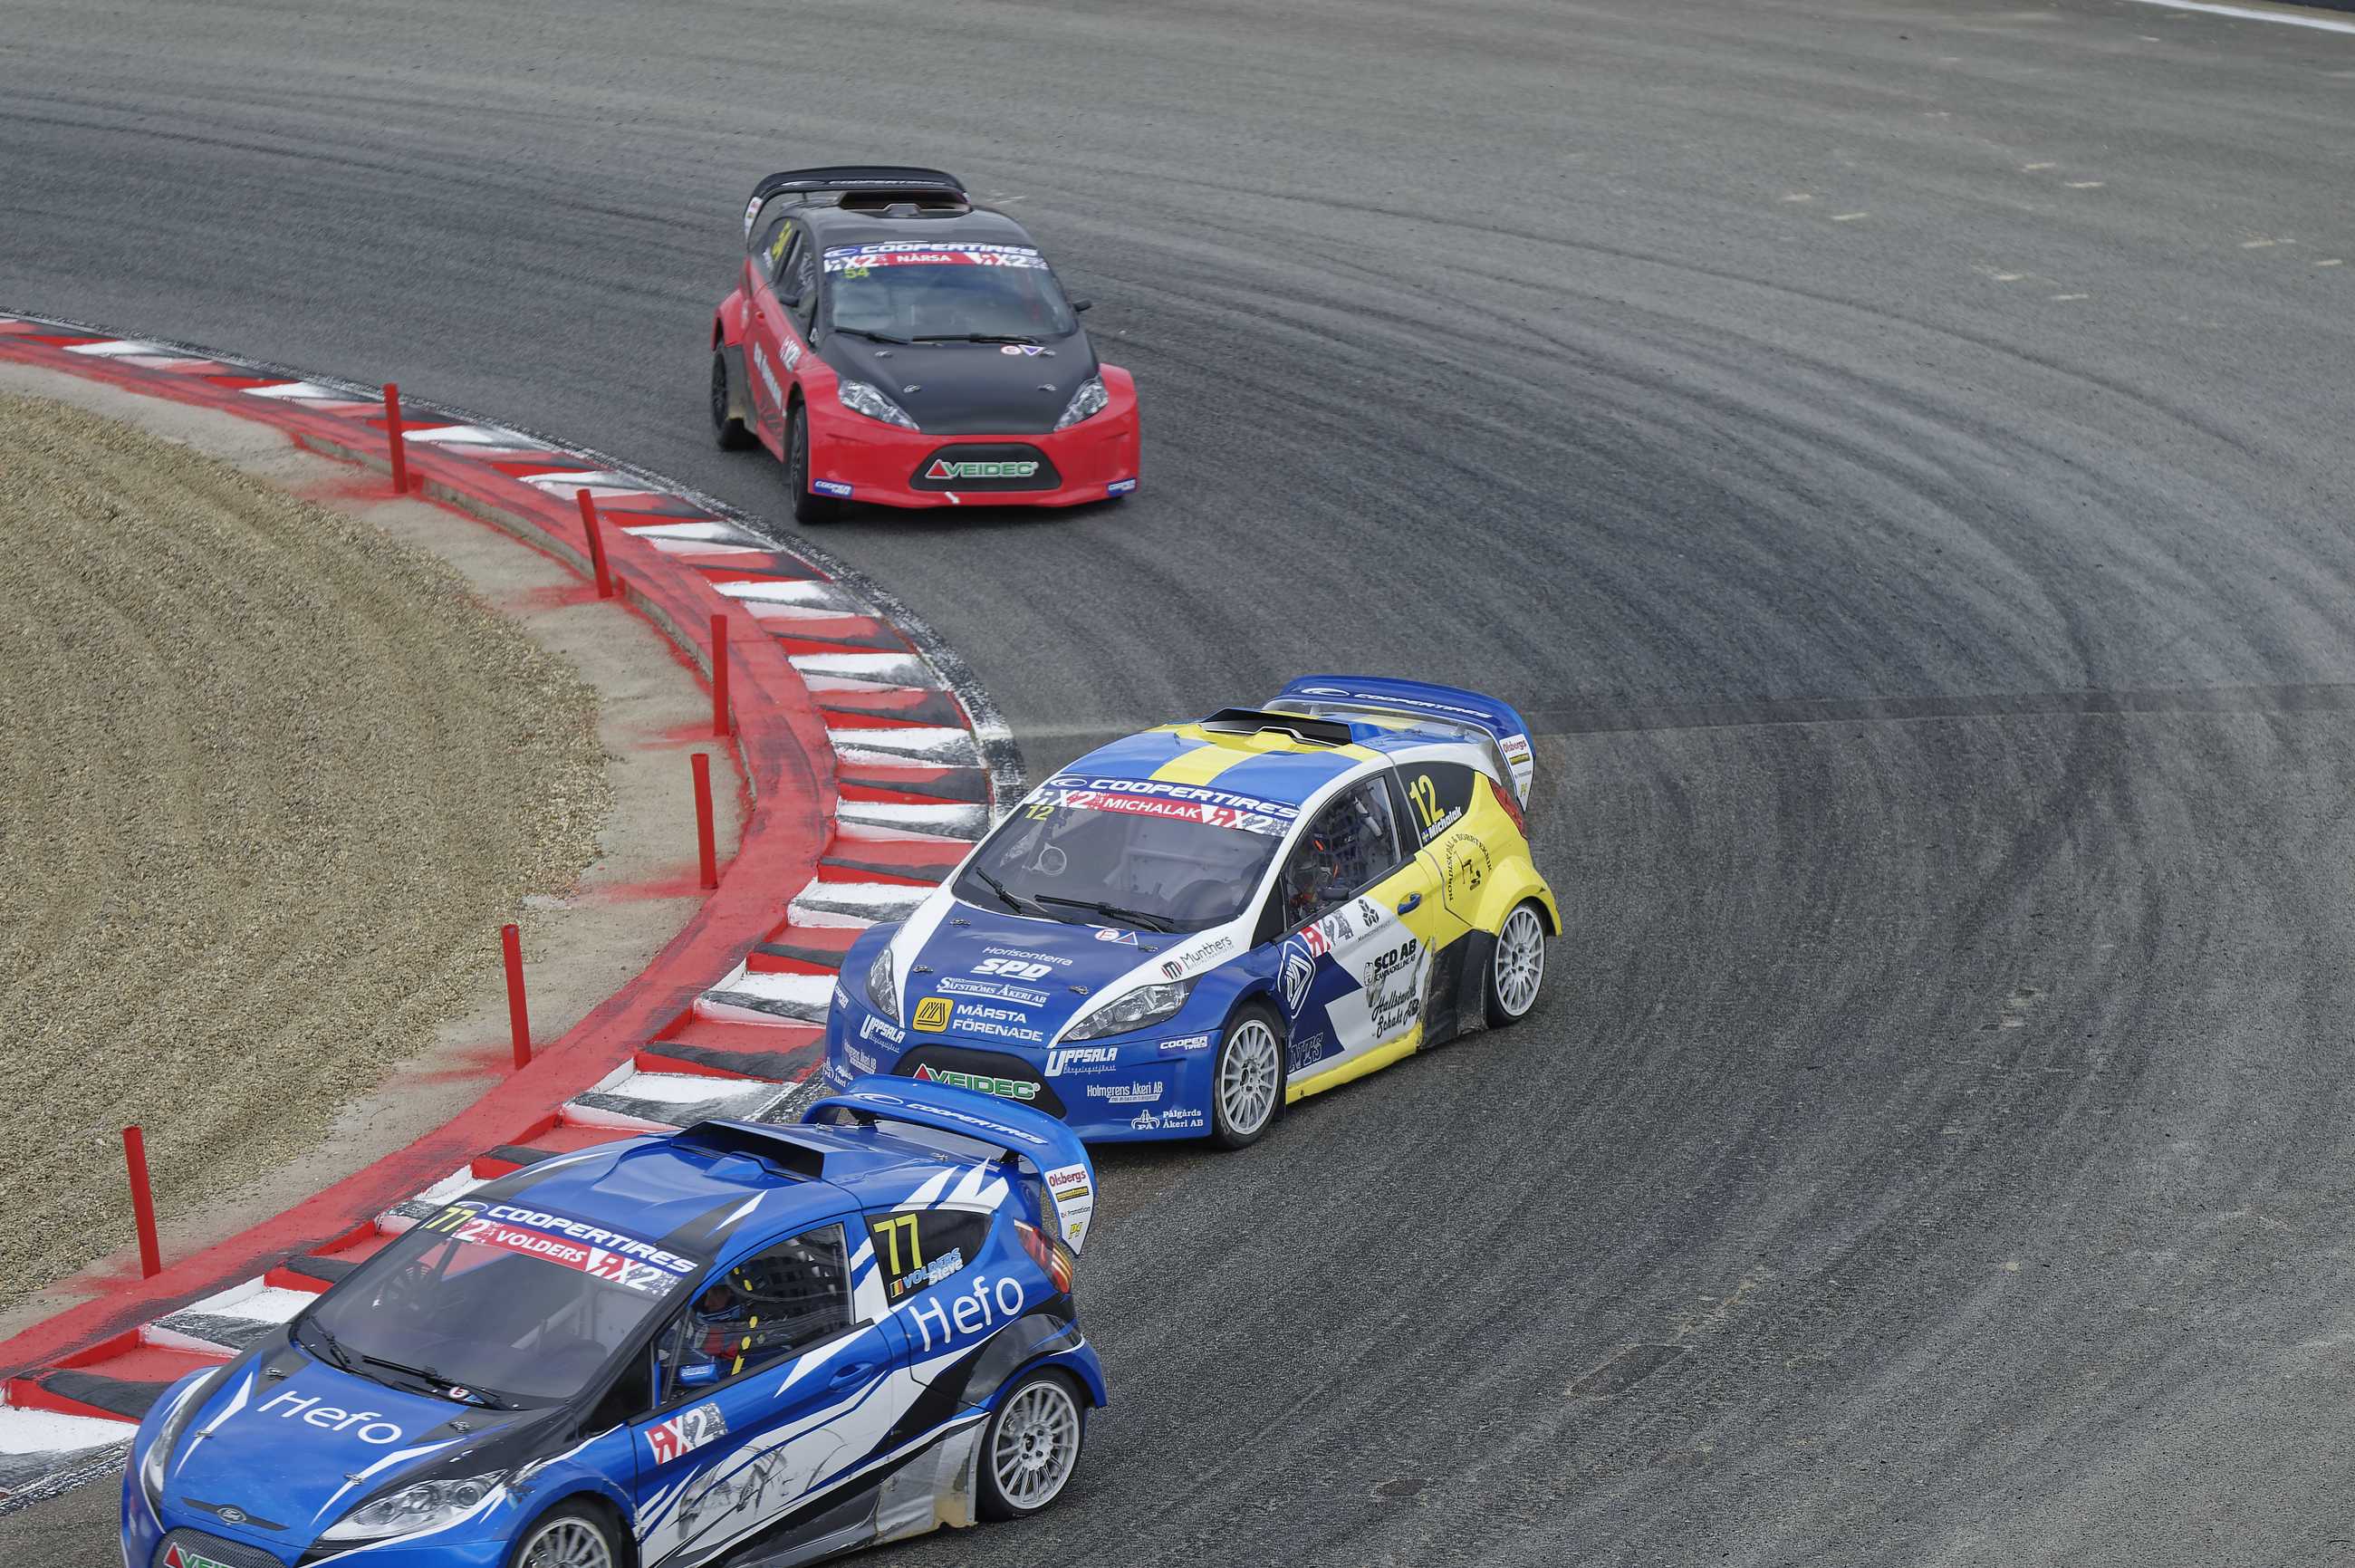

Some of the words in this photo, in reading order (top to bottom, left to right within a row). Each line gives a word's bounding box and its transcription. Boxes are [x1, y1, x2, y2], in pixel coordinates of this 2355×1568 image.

[844, 267, 870, 278] 54
[945, 461, 1033, 477] VEIDEC
[1089, 779, 1301, 818] COOPERTIRES
[1105, 797, 1202, 820] MICHALAK
[1409, 774, 1446, 827] 12
[1025, 805, 1055, 821] 12
[1427, 806, 1463, 839] Michalak
[983, 947, 1073, 966] Horisonterra
[1179, 936, 1233, 970] Munthers
[1375, 949, 1398, 974] SCD
[1400, 938, 1417, 960] AB
[974, 958, 1053, 978] SPD
[996, 984, 1032, 1001] ÅKERI
[1032, 996, 1047, 1004] AB
[956, 1004, 1026, 1024] MÄRSTA
[860, 1014, 906, 1044] UPPSALA
[952, 1018, 1044, 1042] FÖRENADE
[1160, 1035, 1208, 1050] COOPER
[1185, 1043, 1208, 1051] TIRES
[1044, 1047, 1119, 1076] UPPSALA
[928, 1067, 1035, 1100] VEIDEC
[1087, 1084, 1129, 1098] Holmgrens
[1132, 1082, 1151, 1095] Åkeri
[1154, 1082, 1163, 1093] AB
[1163, 1109, 1202, 1120] Pålgårds
[1163, 1119, 1188, 1129] Åkeri
[1190, 1119, 1204, 1128] AB
[1049, 1170, 1086, 1187] Olsbergs
[425, 1207, 477, 1232] 77
[487, 1206, 698, 1273] COOPERTIRES
[495, 1230, 588, 1264] VOLDERS
[872, 1213, 922, 1275] 77
[928, 1258, 964, 1285] Steve
[908, 1275, 1024, 1352] Hefo
[256, 1390, 402, 1444] Hefo
